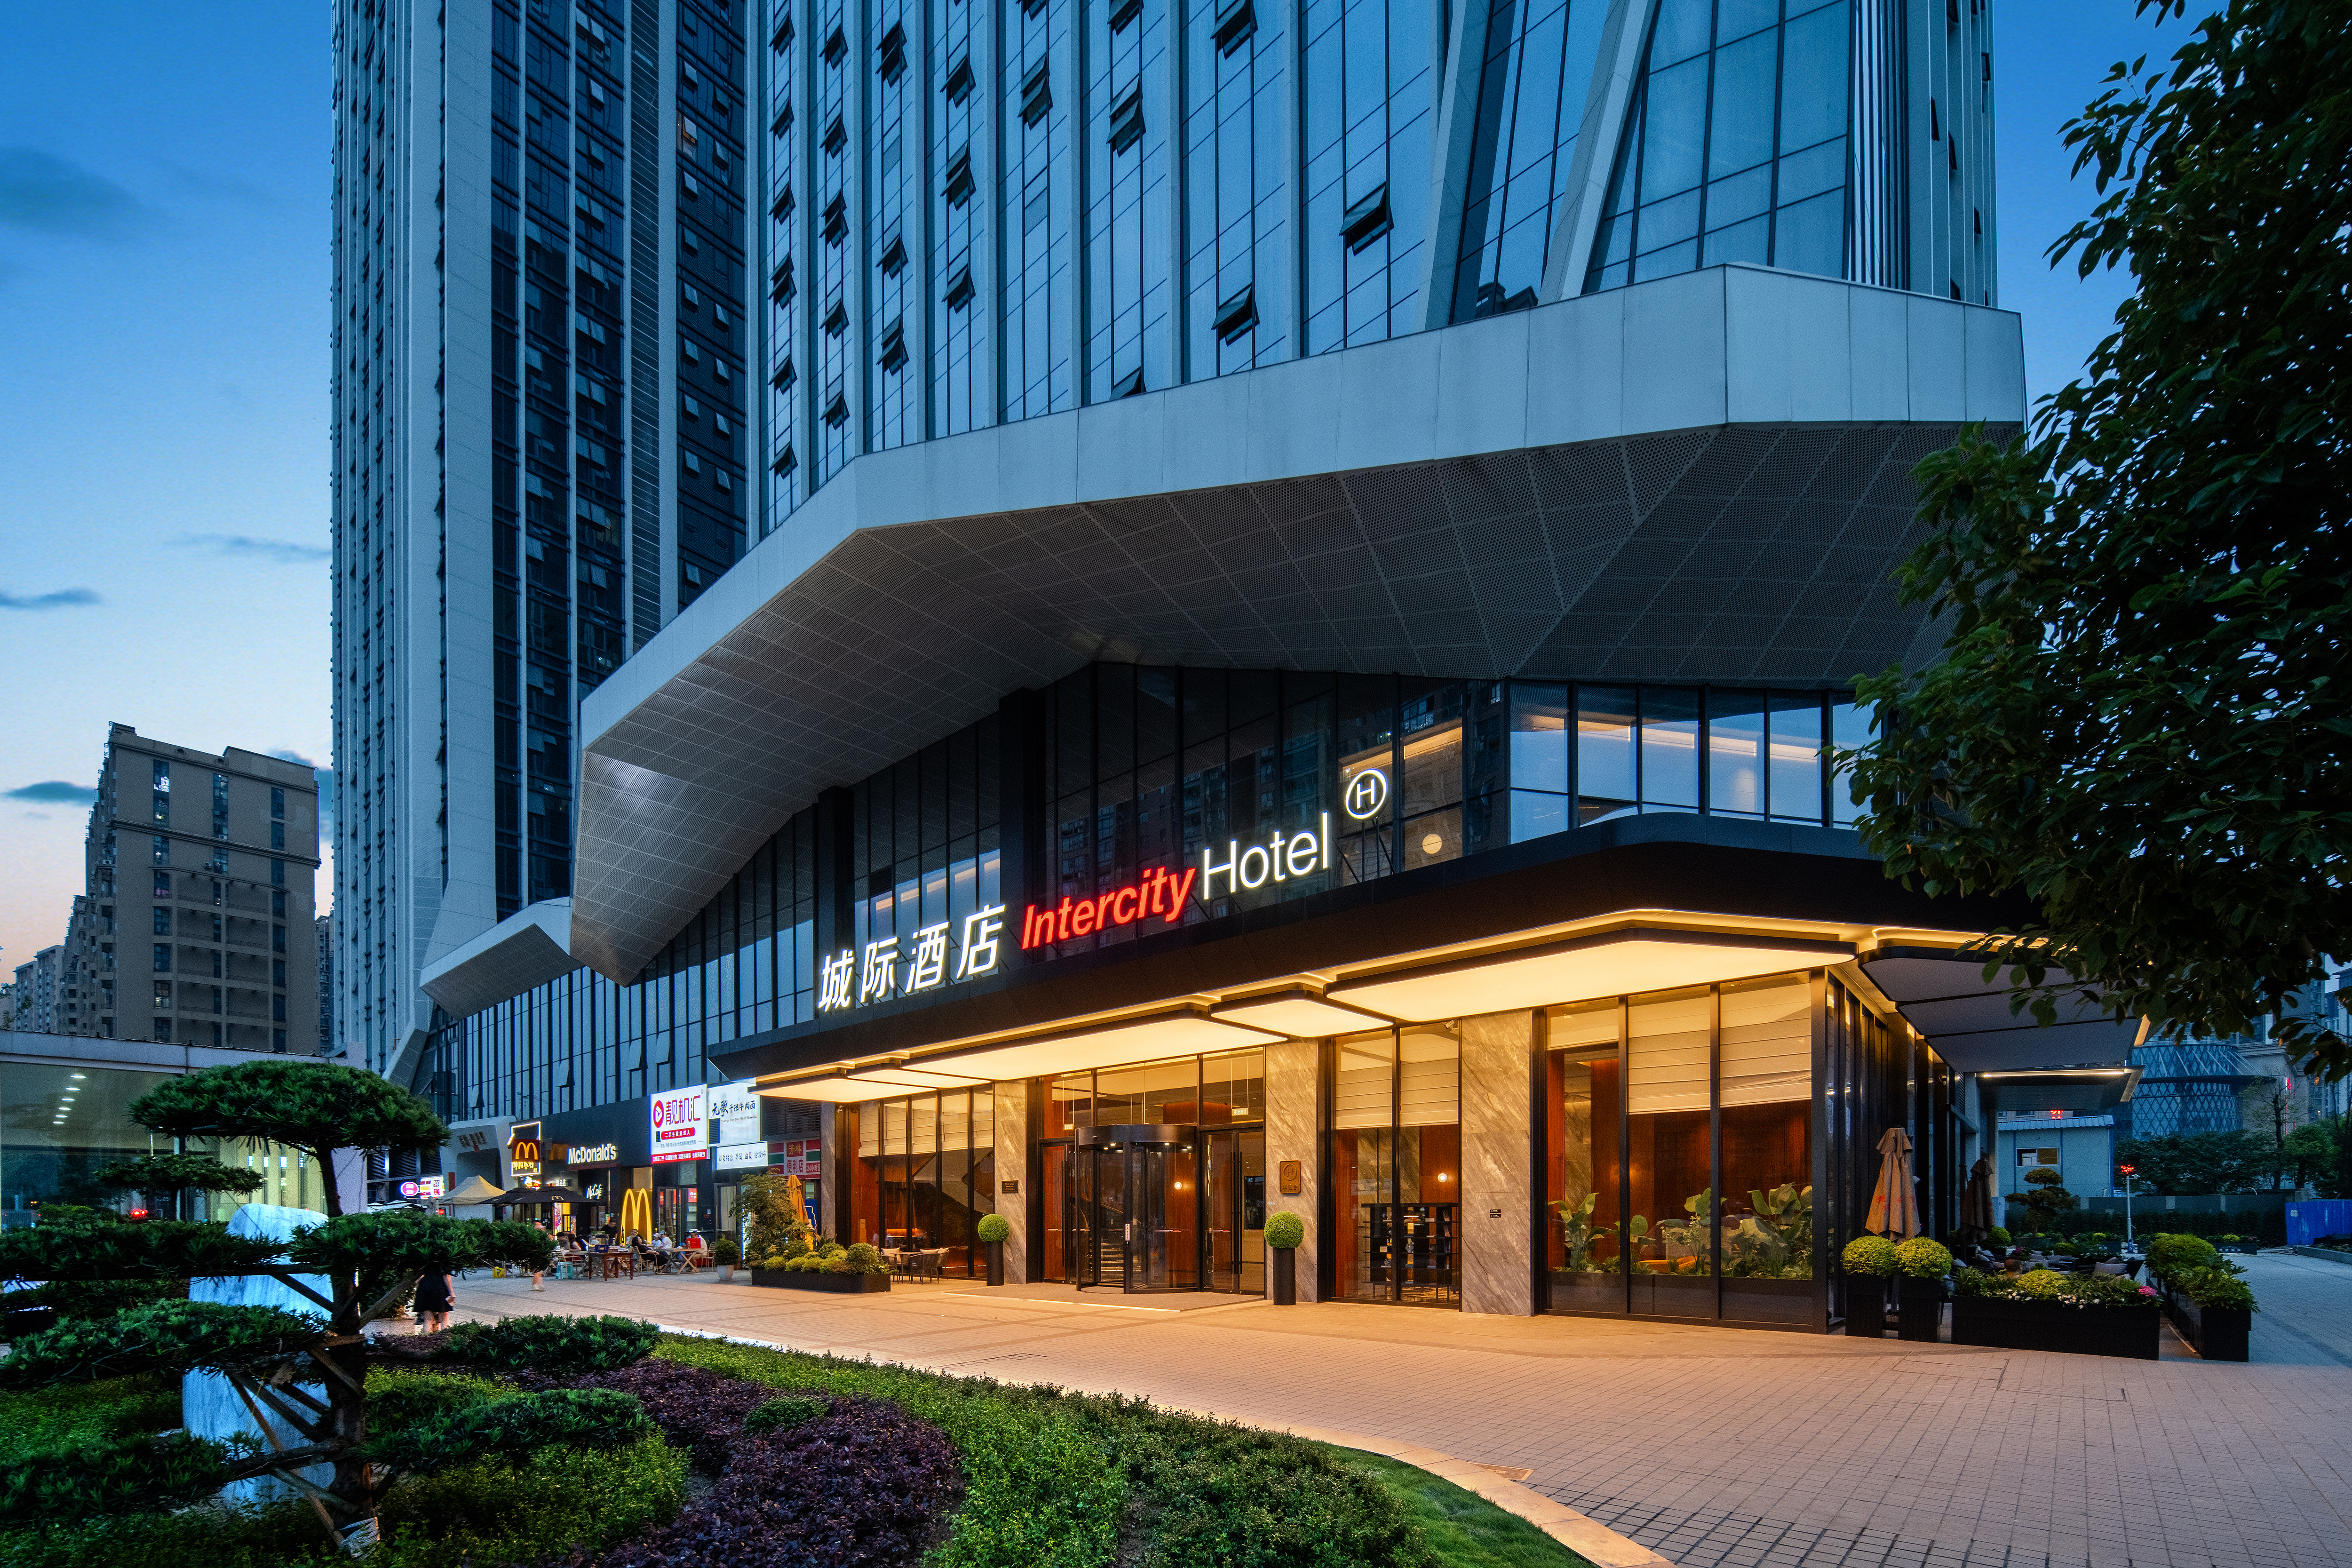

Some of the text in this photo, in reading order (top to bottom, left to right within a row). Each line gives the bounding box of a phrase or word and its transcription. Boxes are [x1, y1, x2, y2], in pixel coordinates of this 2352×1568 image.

[1022, 811, 1330, 949] Intercity Hotel
[818, 904, 1005, 1011] 城际酒店
[666, 1095, 701, 1125] 靓机汇
[567, 1143, 617, 1164] McDonald's
[788, 1144, 802, 1155] 芳林
[787, 1159, 803, 1173] 便利店
[586, 1184, 603, 1200] McCafé
